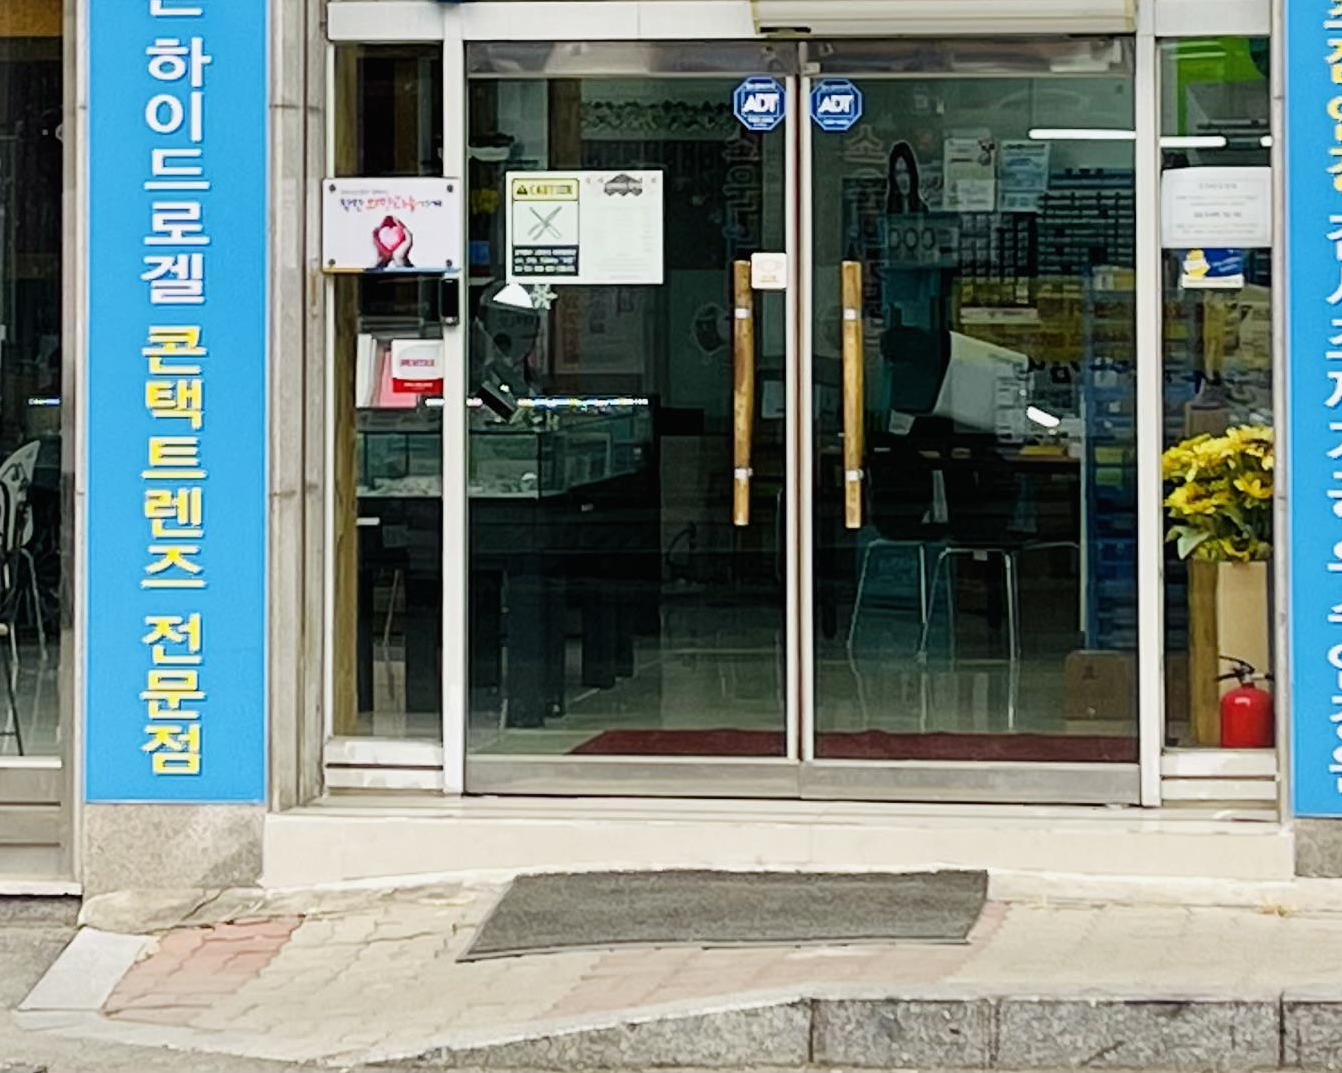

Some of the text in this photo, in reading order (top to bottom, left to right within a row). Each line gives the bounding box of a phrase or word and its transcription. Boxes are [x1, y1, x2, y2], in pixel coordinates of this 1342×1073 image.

[141, 38, 211, 303] 하이드로겔
[741, 93, 779, 113] ADT
[818, 94, 854, 113] ADT
[141, 326, 206, 587] 콘택트렌즈
[140, 613, 205, 774] 전문점
